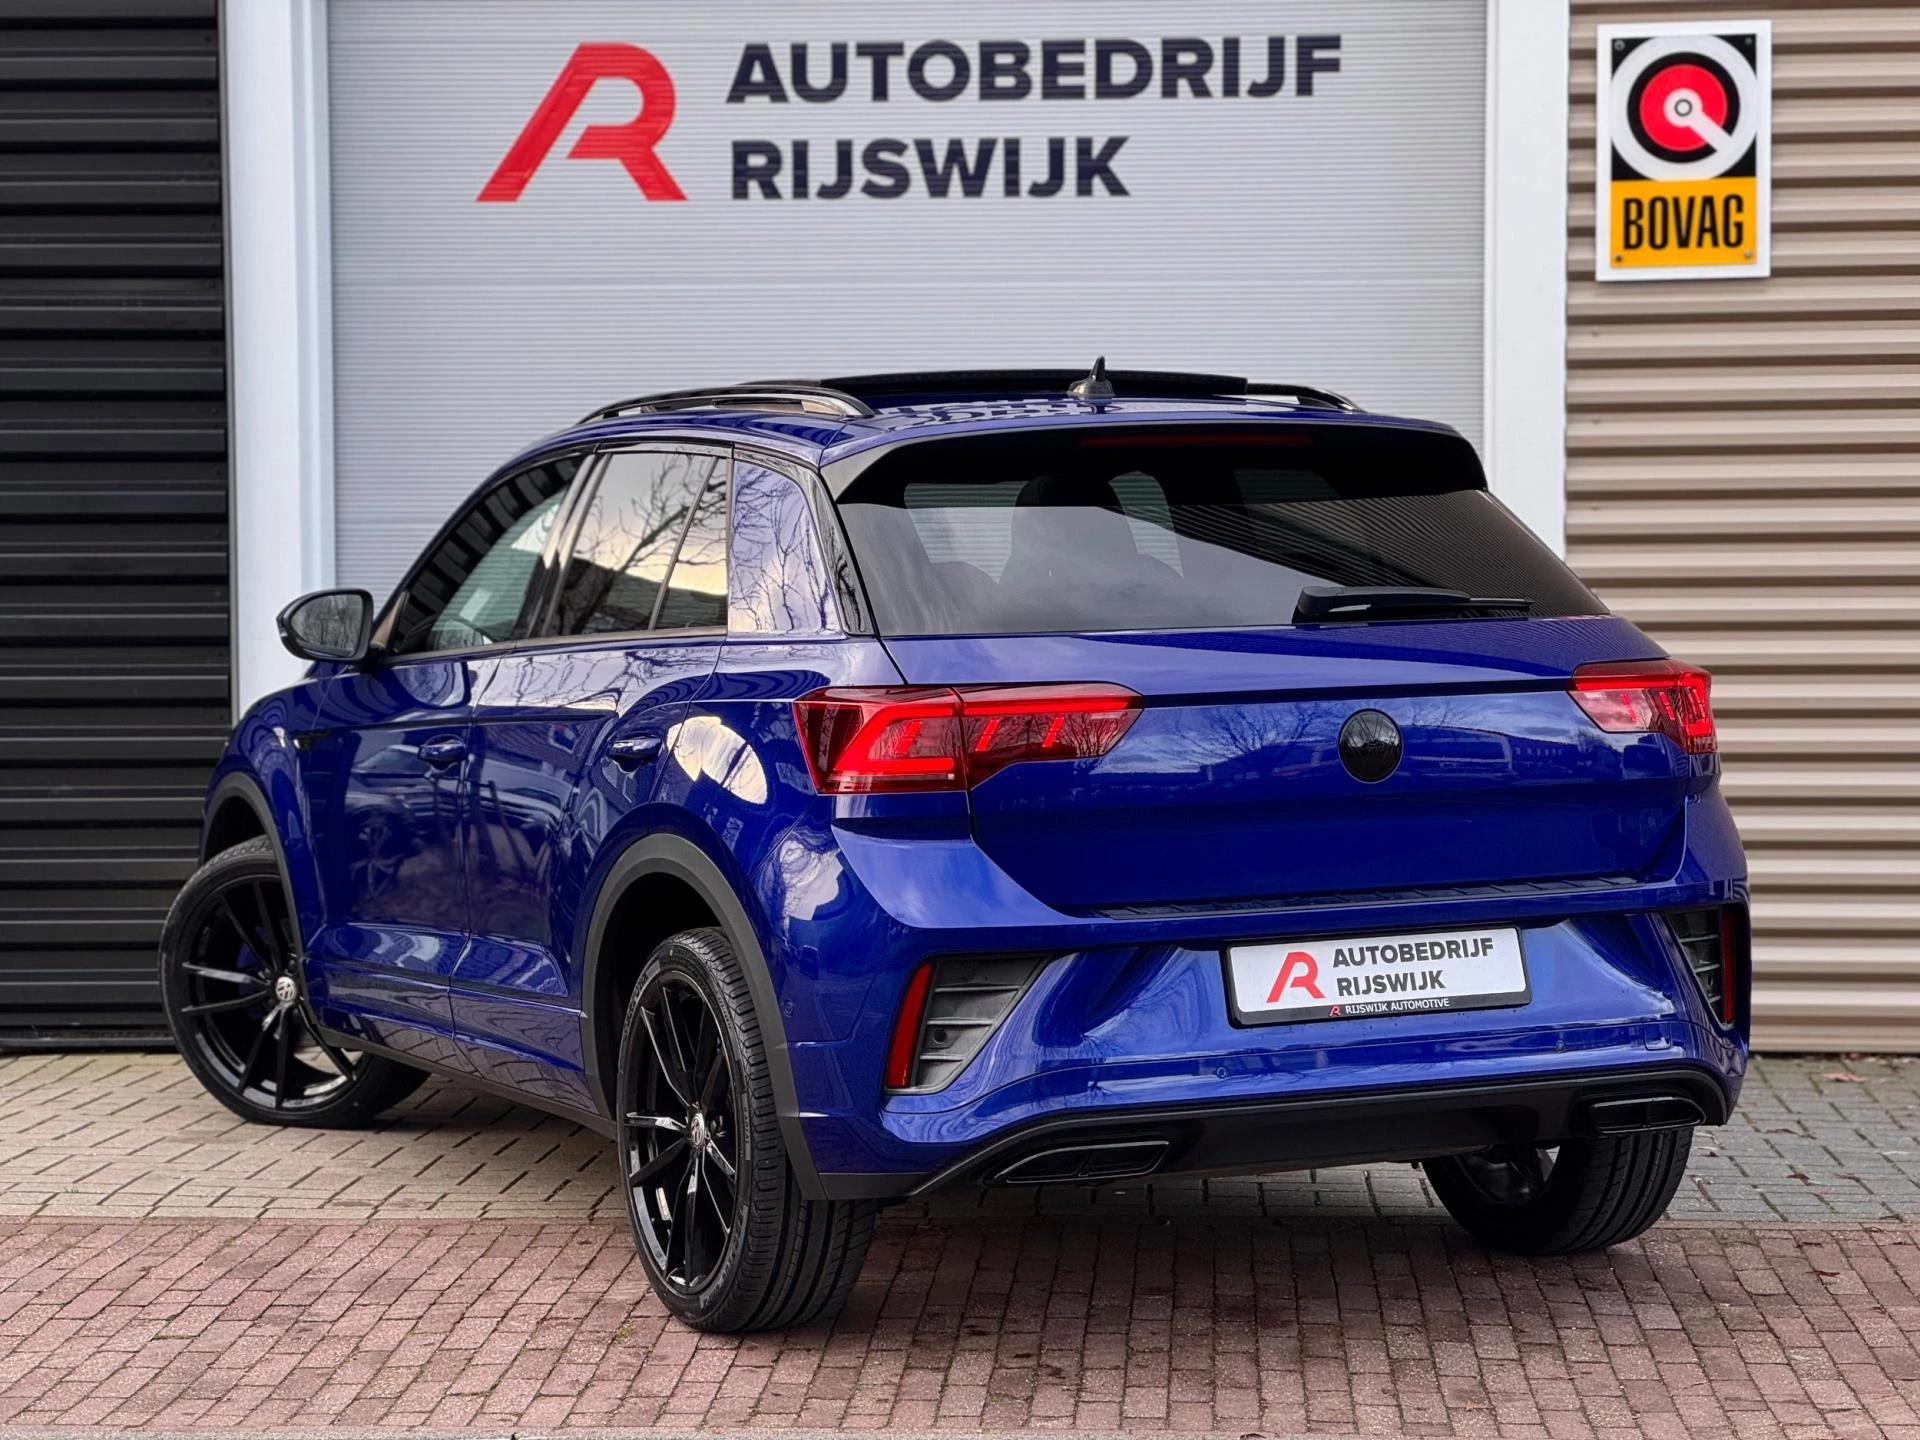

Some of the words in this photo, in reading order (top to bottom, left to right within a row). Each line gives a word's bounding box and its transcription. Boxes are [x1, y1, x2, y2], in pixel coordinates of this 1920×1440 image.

[726, 34, 1342, 103] AUTOBEDRIJF
[731, 136, 1131, 200] RIJSWIJK
[1623, 194, 1744, 250] BOVAG
[1332, 937, 1494, 968] AUTOBEDRIJF
[1336, 969, 1446, 997] RIJSWIJK
[1345, 1002, 1389, 1015] RIJSWIJK
[1390, 997, 1450, 1012] AUTOMOTIVE
